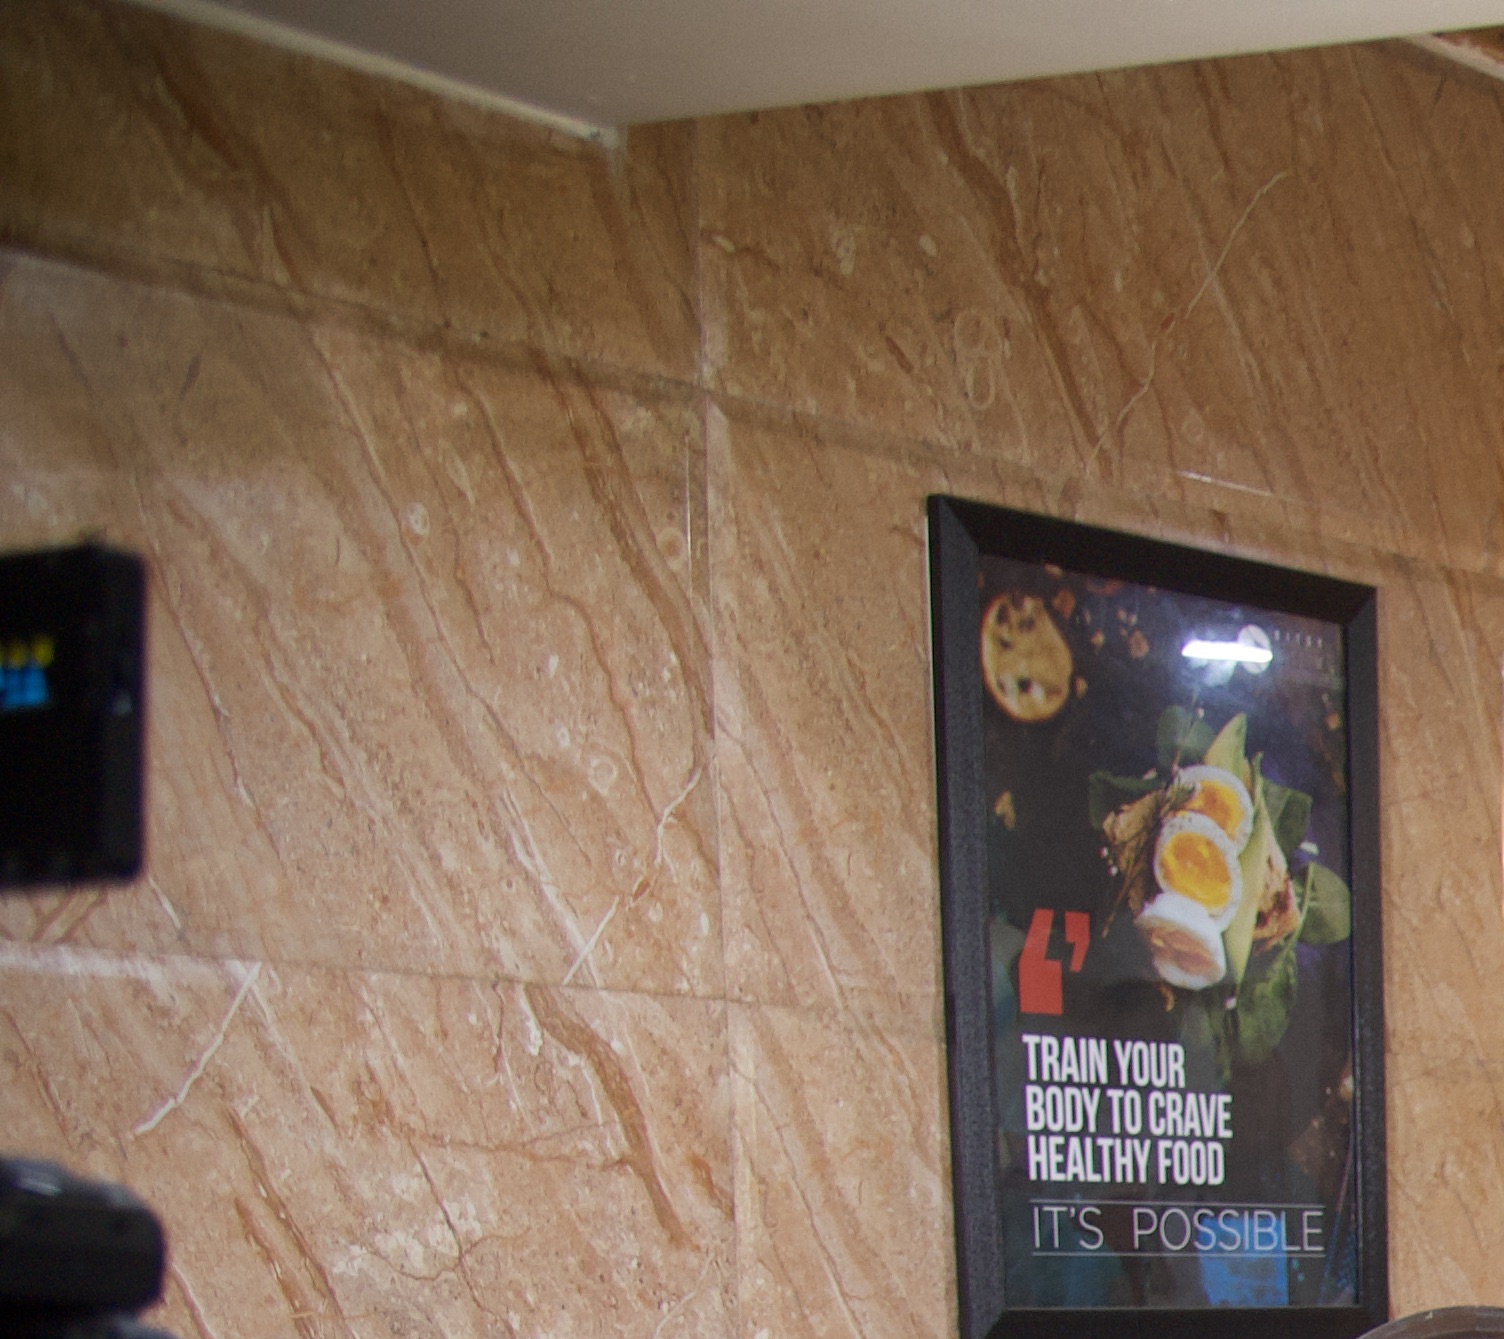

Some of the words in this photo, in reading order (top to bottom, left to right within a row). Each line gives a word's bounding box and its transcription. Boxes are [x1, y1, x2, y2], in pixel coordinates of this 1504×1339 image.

[1022, 1034, 1107, 1085] TRAIN
[1113, 1039, 1186, 1088] YOUR
[1025, 1085, 1101, 1132] BODY
[1106, 1088, 1142, 1135] TO
[1150, 1091, 1233, 1138] CRAVE
[1028, 1135, 1151, 1184] HEALTHY
[1158, 1140, 1225, 1185] FOOD
[1033, 1206, 1104, 1250] IT'S
[1132, 1207, 1325, 1251] POSSIBLE
